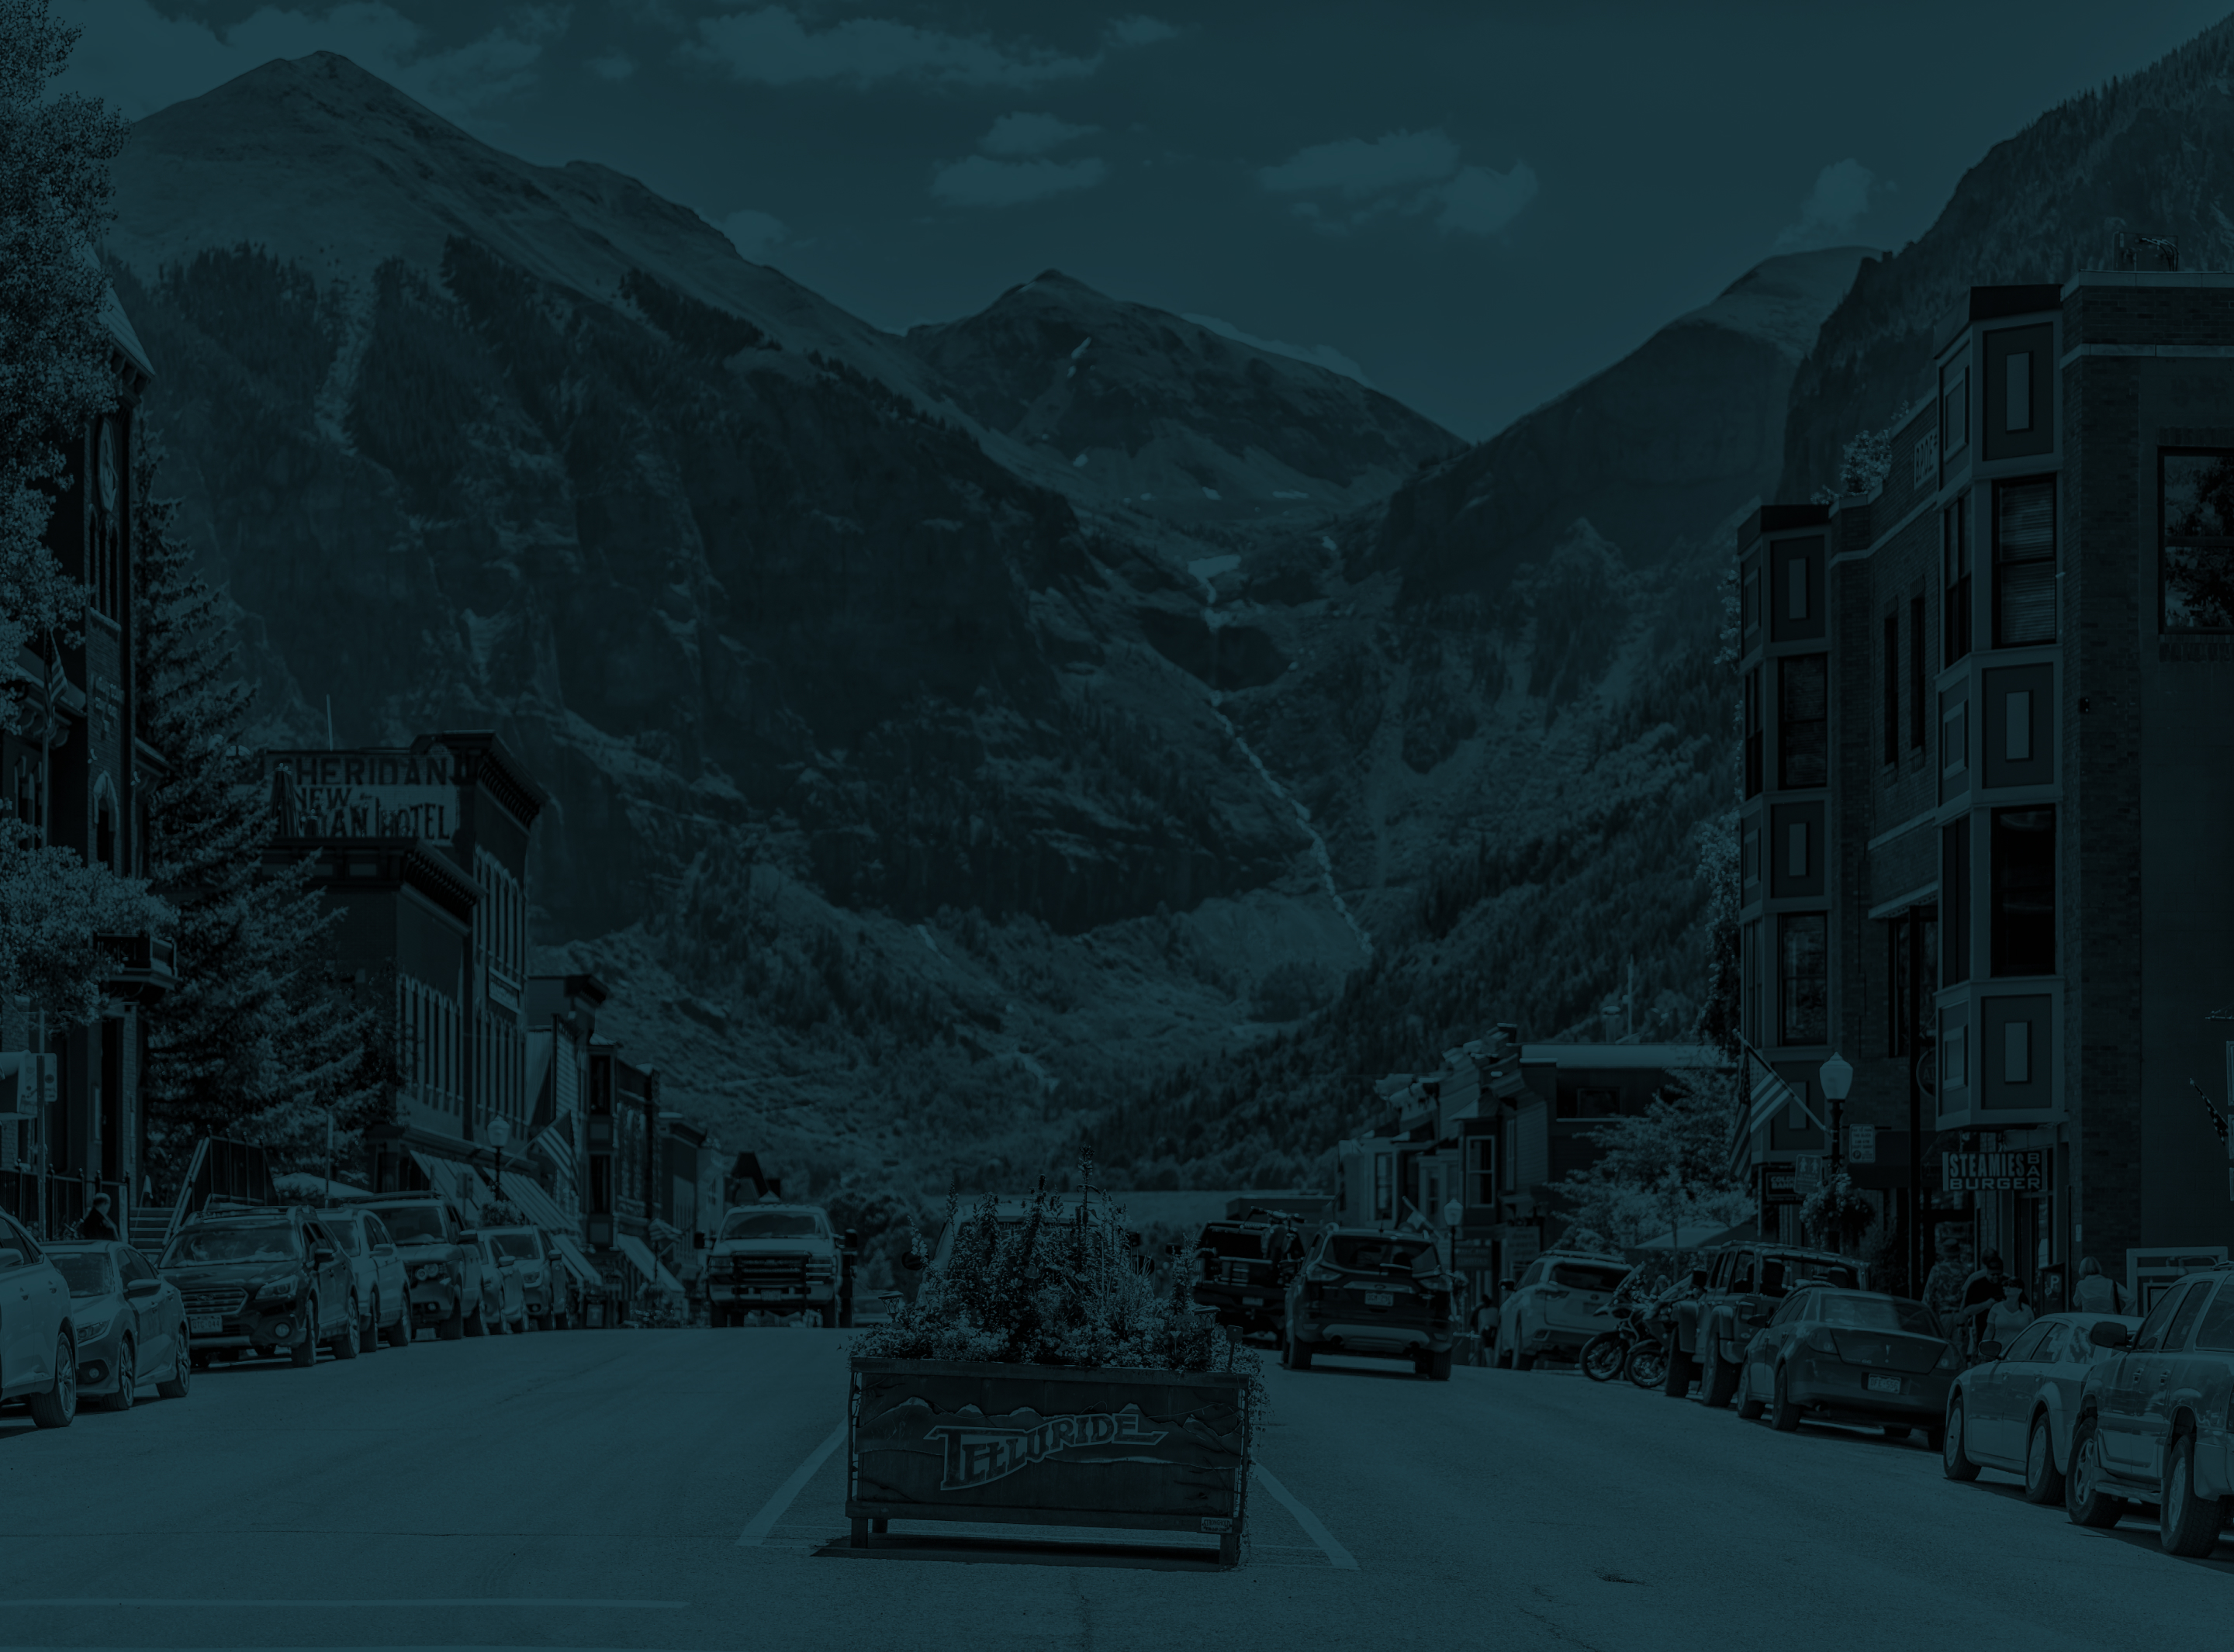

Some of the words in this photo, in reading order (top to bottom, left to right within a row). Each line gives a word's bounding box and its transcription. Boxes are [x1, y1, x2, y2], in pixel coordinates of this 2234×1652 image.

[1949, 1153, 2025, 1177] STEAMIES
[1949, 1177, 2041, 1191] BURGER
[2050, 1275, 2059, 1290] P
[922, 1413, 1169, 1491] TELLURIDE
[1203, 1519, 1230, 1530] STRONGHOLD
